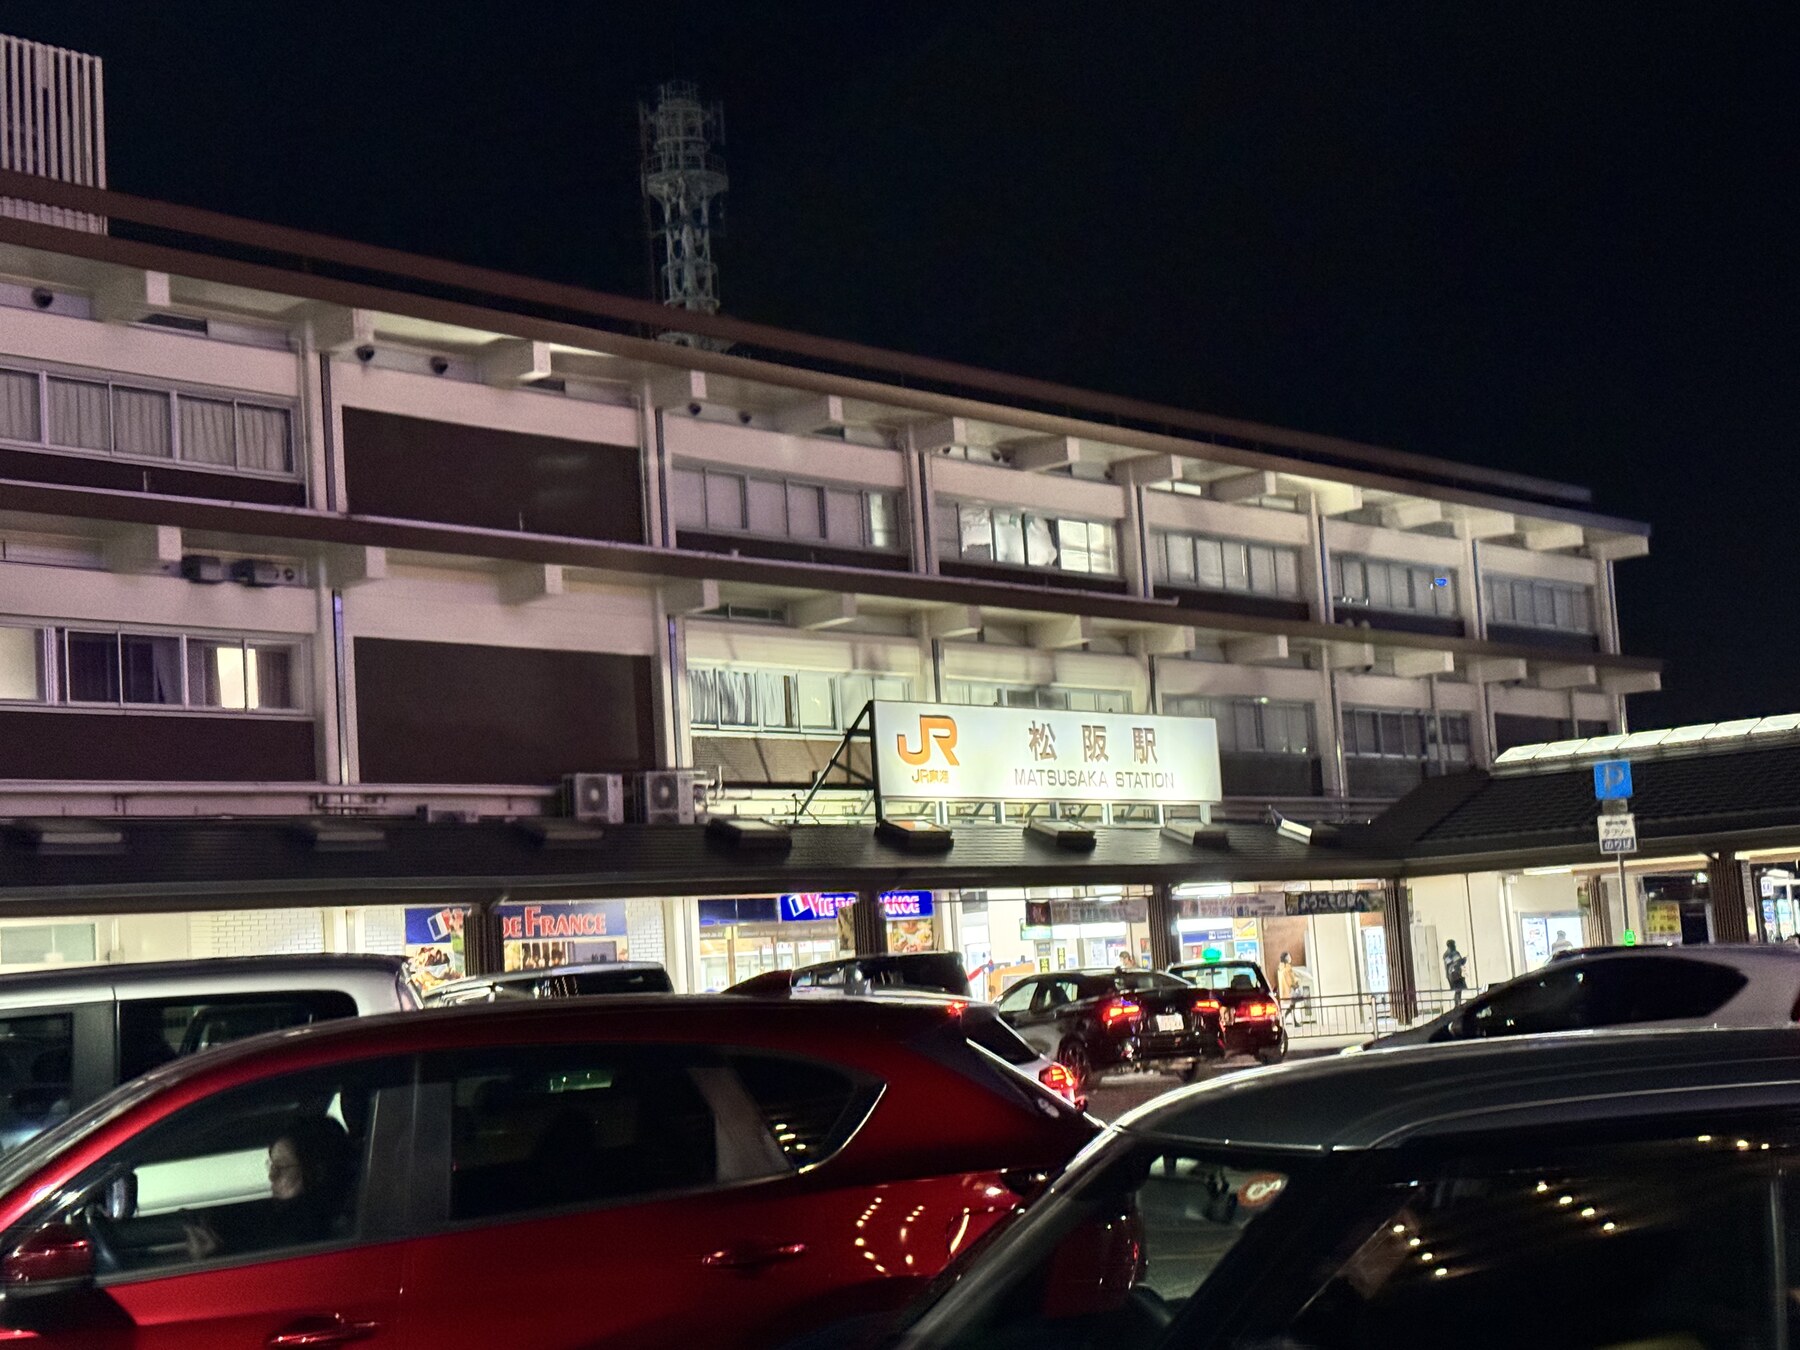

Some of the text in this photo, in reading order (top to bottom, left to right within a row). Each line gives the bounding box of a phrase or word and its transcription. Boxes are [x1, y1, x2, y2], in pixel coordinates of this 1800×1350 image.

[897, 714, 960, 766] JR
[1028, 720, 1158, 764] 松阪駅
[1014, 768, 1174, 789] MATSUSAKA STATION
[1604, 766, 1624, 793] P
[525, 906, 606, 937] FRANCE
